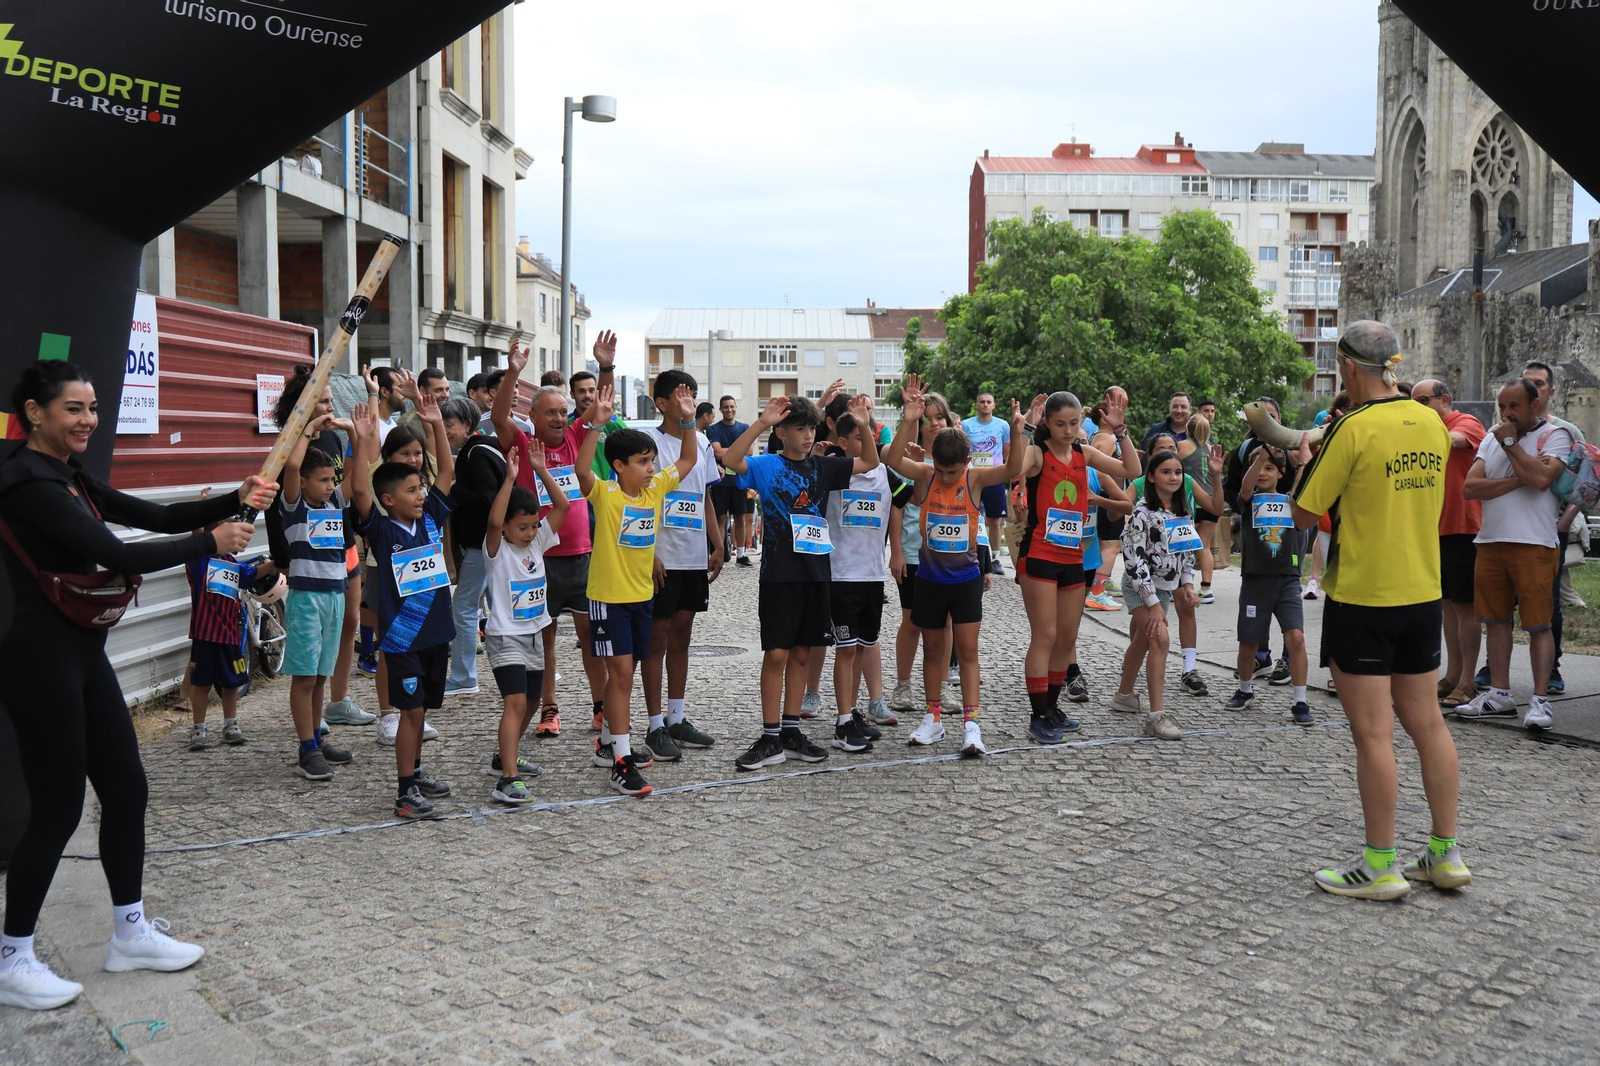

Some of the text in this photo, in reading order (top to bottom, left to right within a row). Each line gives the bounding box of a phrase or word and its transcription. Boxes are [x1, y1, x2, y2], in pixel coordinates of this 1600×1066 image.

[265, 15, 363, 49] Ourense
[4, 53, 182, 109] DEPORTE
[50, 86, 84, 109] La
[125, 343, 155, 377] DÁS
[123, 396, 155, 408] 667 24 76 99
[1385, 451, 1443, 479] KÓRPORE
[555, 476, 572, 487] 31
[678, 501, 696, 513] 320
[857, 501, 876, 511] 328
[1266, 503, 1284, 512] 327
[807, 526, 821, 538] 305
[938, 525, 961, 536] 309
[1059, 521, 1077, 532] 303
[412, 558, 436, 573] 326
[222, 570, 239, 584] 335
[528, 588, 545, 601] 319
[233, 658, 246, 675] 10
